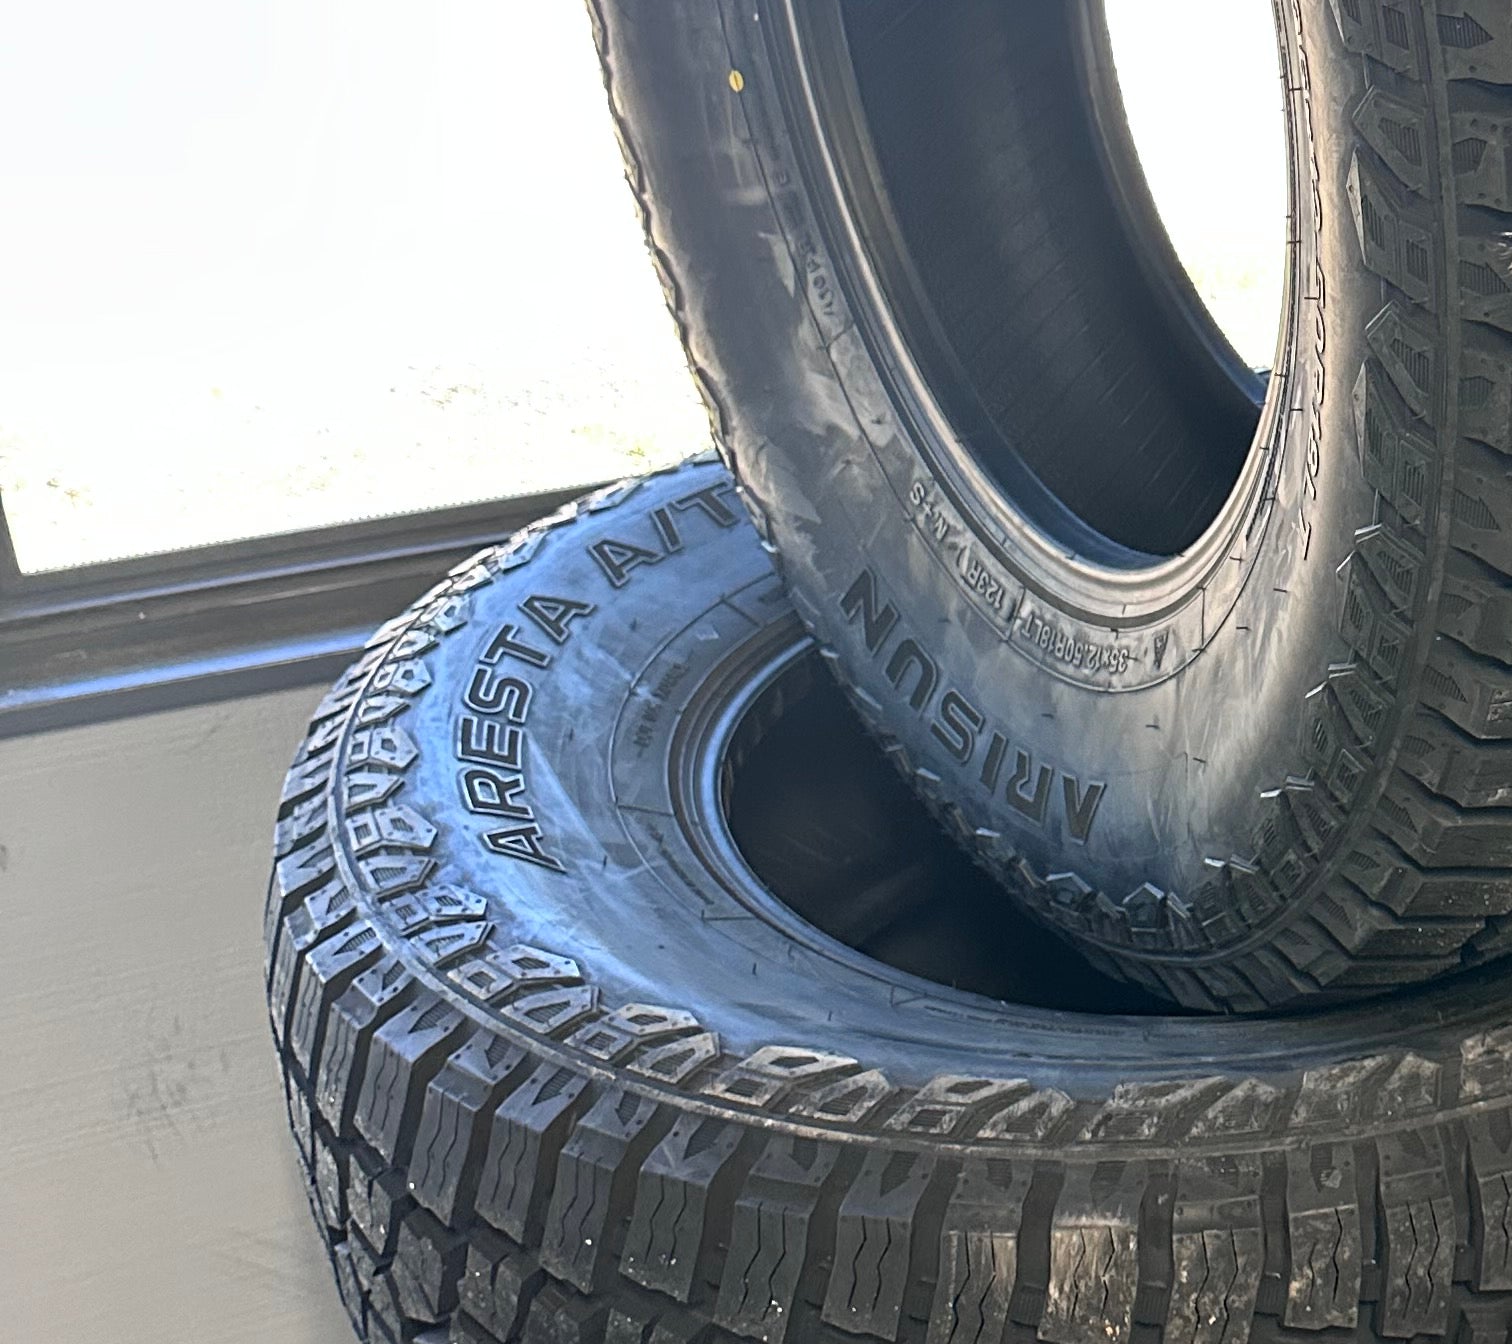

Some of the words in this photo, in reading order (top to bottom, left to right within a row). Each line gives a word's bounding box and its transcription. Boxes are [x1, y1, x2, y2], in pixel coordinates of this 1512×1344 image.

[456, 593, 597, 874] ARESTA
[586, 481, 740, 588] A/T
[838, 567, 1107, 846] ARISUN
